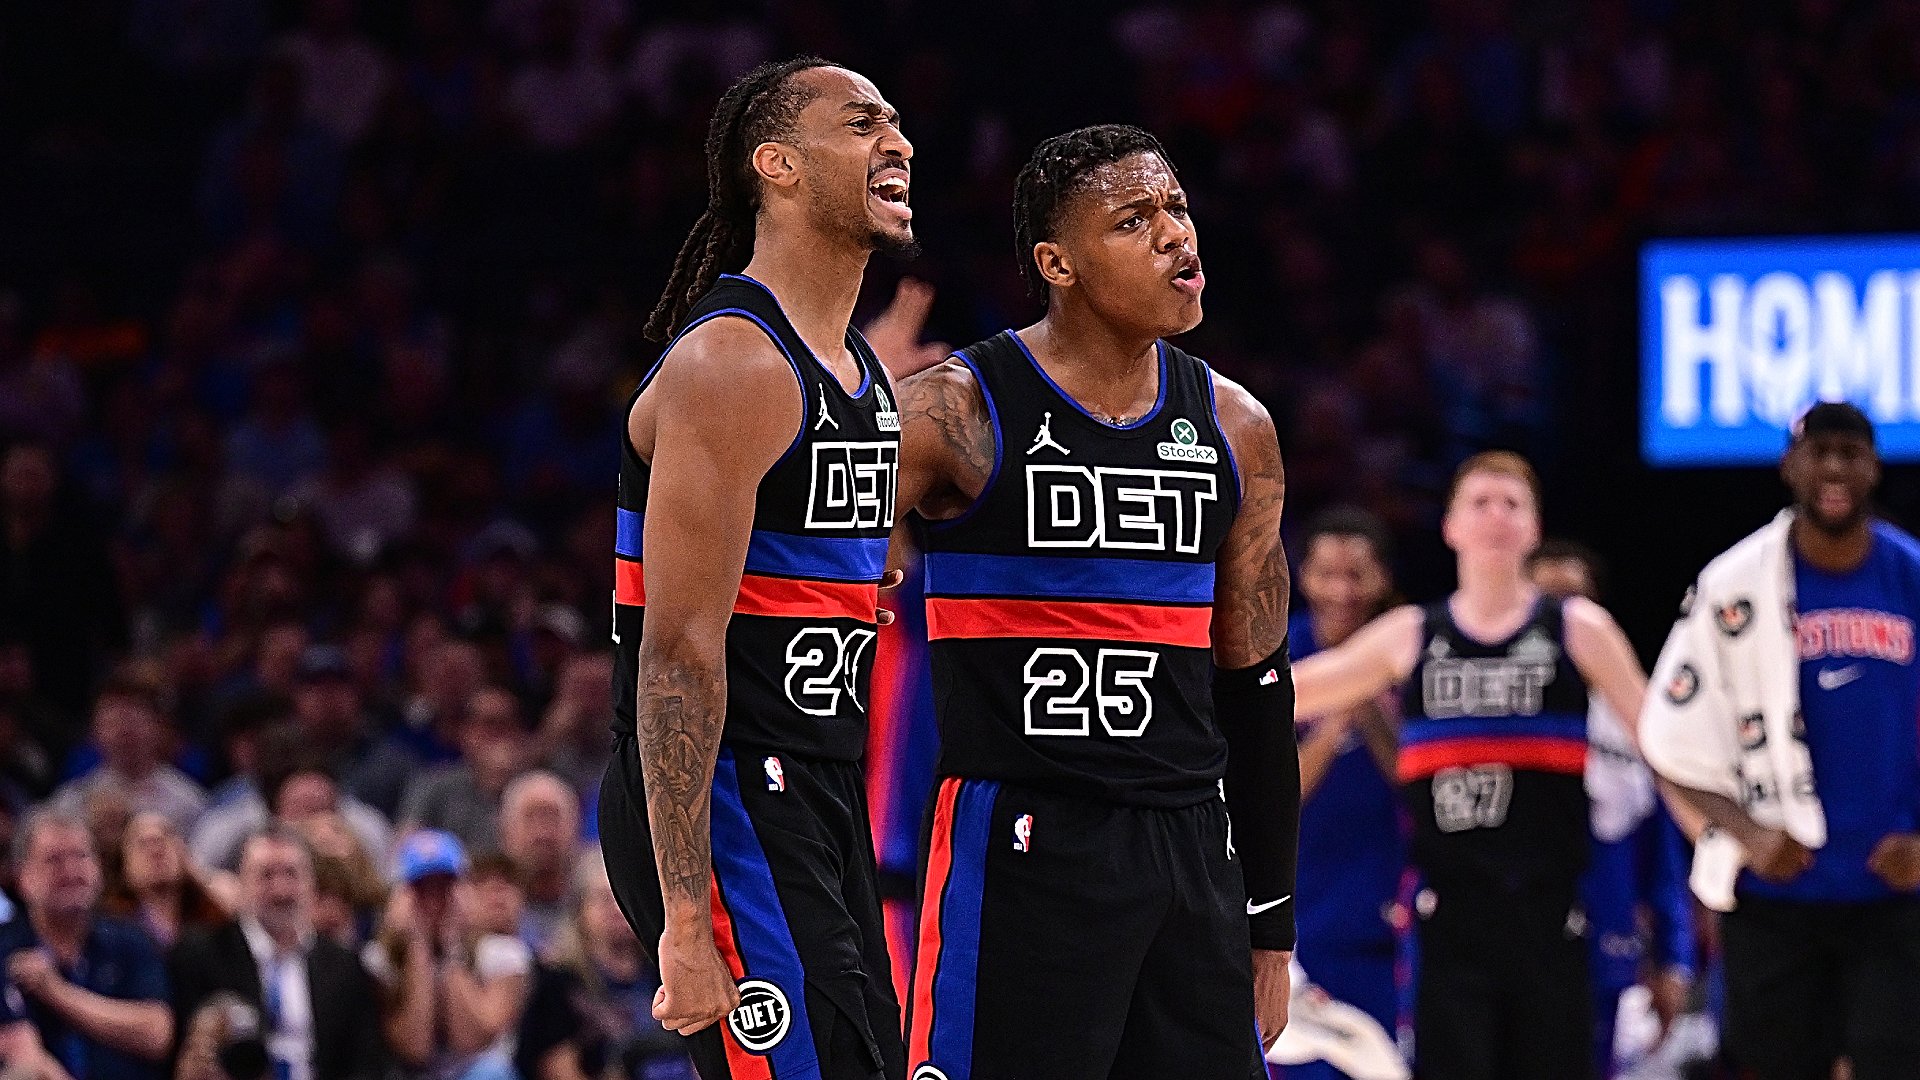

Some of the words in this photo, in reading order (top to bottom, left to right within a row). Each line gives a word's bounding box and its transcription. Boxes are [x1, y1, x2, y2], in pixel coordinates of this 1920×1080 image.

[1661, 268, 1920, 428] HOM
[804, 441, 898, 528] DET
[1160, 445, 1215, 460] StockX
[1026, 464, 1217, 554] DET
[1024, 648, 1159, 737] 25
[1422, 656, 1557, 720] DET
[738, 999, 777, 1030] DET
